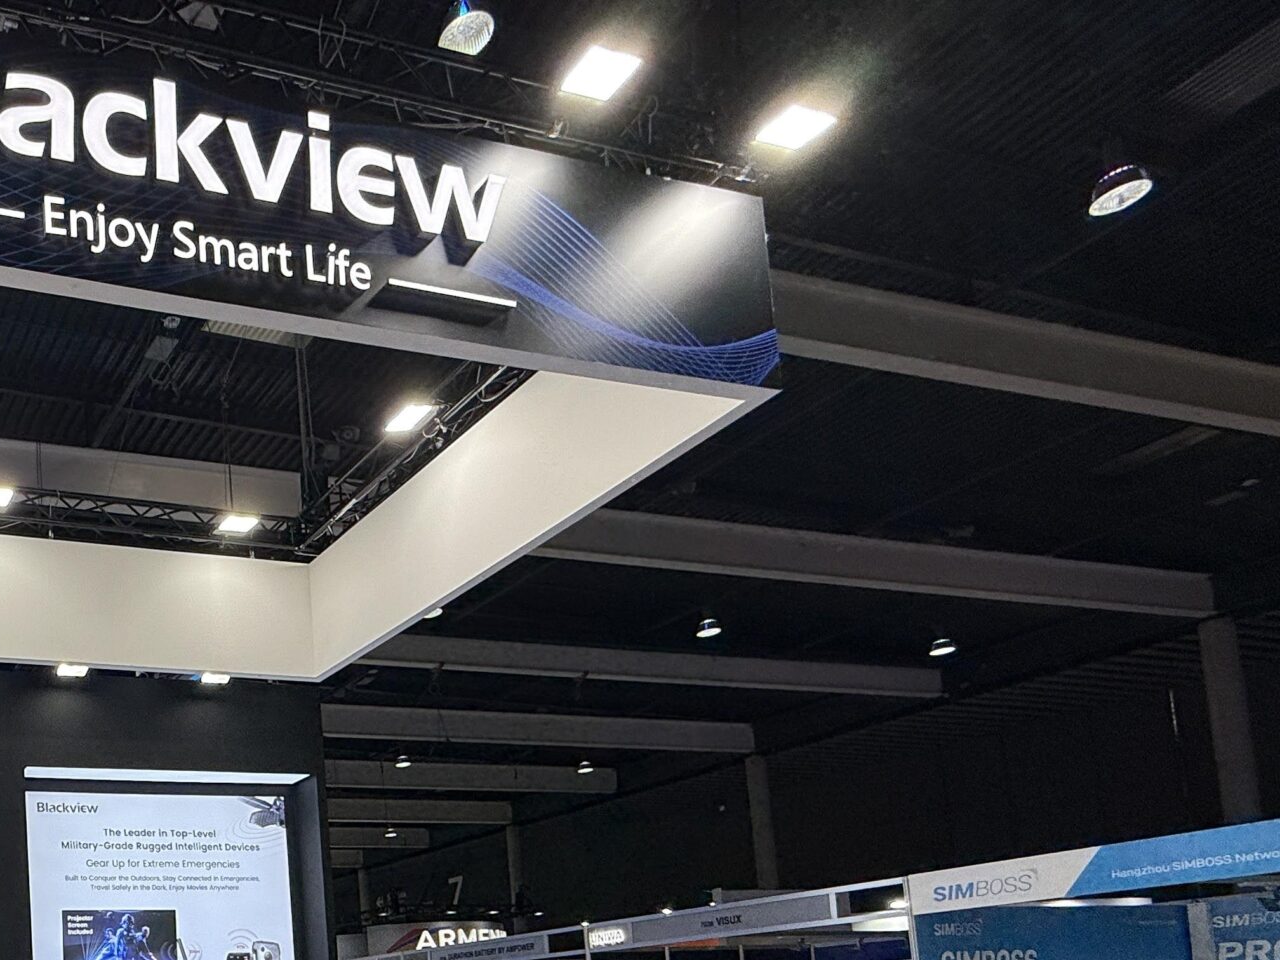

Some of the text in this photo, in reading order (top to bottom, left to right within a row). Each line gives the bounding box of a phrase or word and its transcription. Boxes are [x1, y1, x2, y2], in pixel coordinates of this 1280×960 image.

[42, 194, 373, 290] Enjoy Smart Life
[36, 802, 99, 814] Blackview
[103, 828, 216, 839] The Leader in Top-Level
[61, 841, 260, 853] Military-Grade Rugged Intelligent Devices
[86, 859, 240, 870] Gear Up for Extreme Emergencies
[1111, 864, 1170, 879] Hangzhou
[1172, 854, 1232, 871] SIMBOSS
[88, 875, 117, 883] Conquer
[448, 875, 463, 905] 7
[933, 873, 1032, 902] SIMBOSS
[716, 914, 742, 925] VISUX
[933, 922, 982, 936] SIMBOSS
